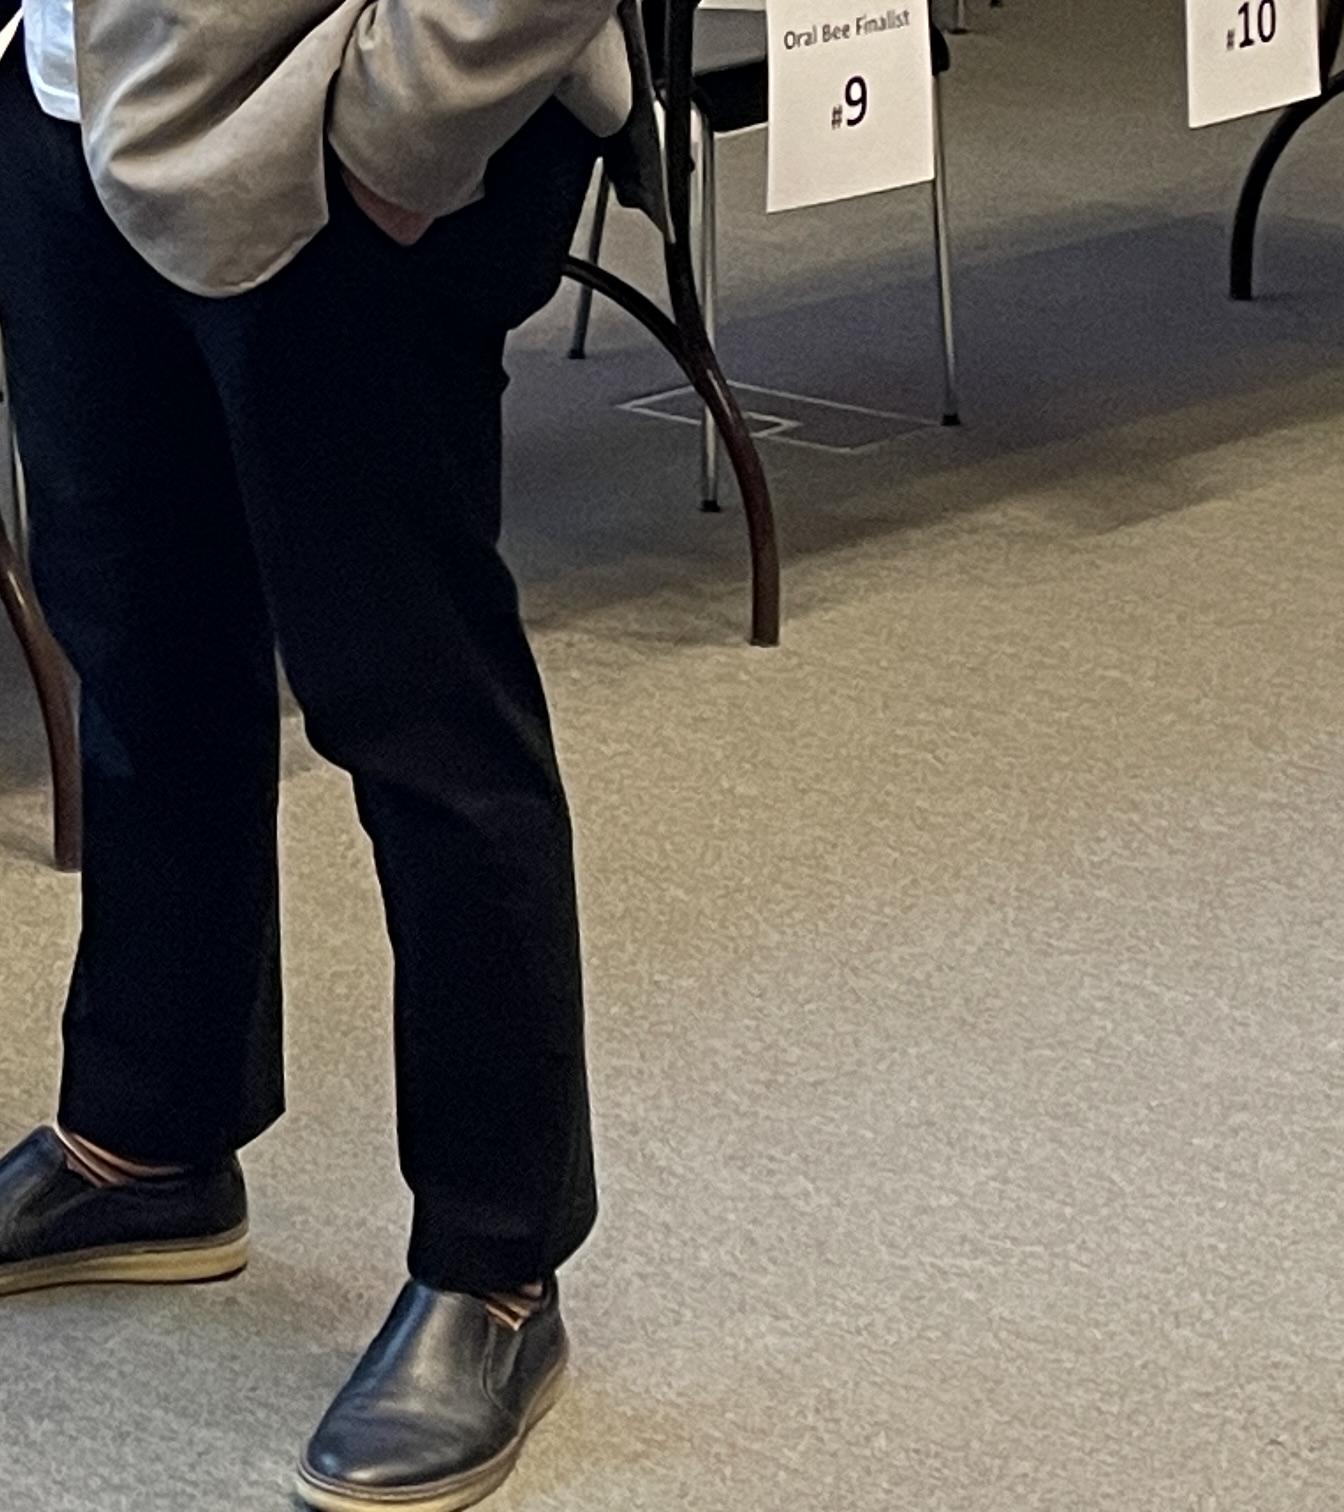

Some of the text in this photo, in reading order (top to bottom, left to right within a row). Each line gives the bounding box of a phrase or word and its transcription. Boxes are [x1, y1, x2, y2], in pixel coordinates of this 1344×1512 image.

[783, 24, 818, 51] Oral
[821, 23, 851, 44] Bee
[830, 75, 868, 130] #9
